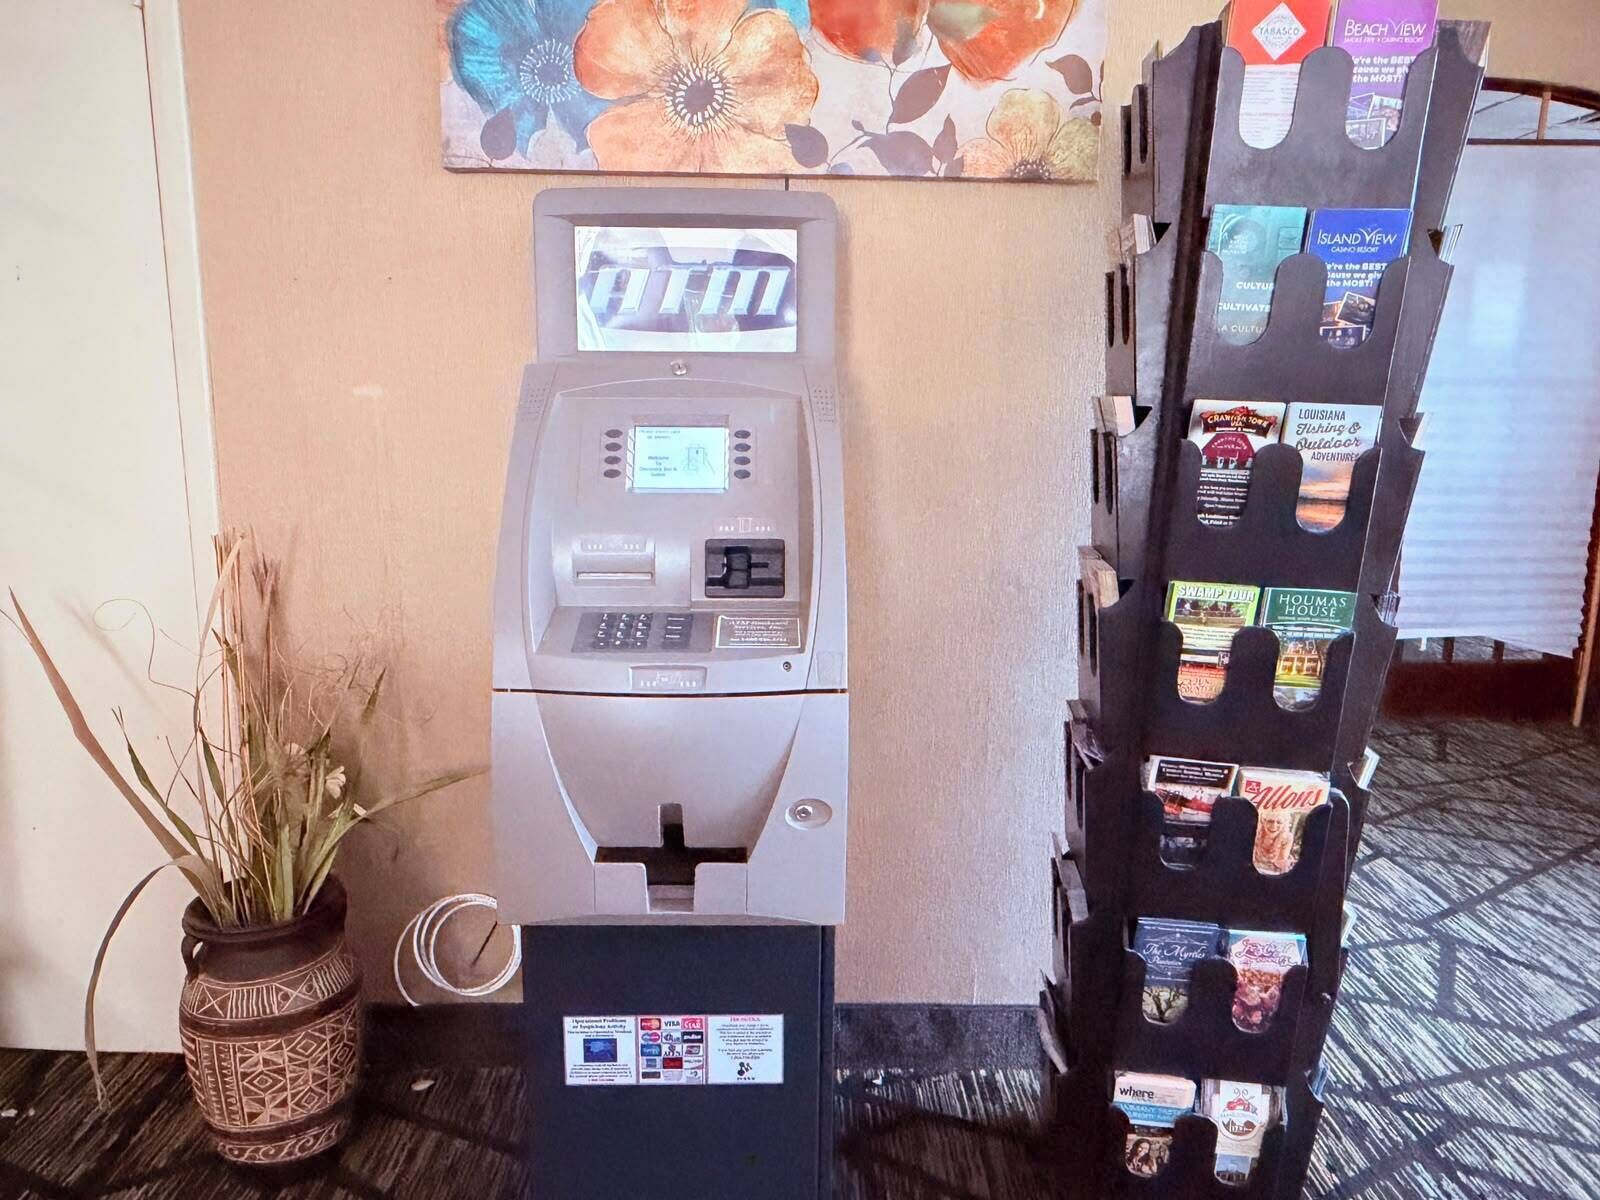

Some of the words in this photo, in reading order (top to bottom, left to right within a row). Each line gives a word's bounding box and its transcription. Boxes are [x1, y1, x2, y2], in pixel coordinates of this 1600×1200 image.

[1258, 24, 1300, 37] TABASCO
[1344, 19, 1388, 36] BEACH
[1389, 18, 1427, 36] VIEW
[1373, 56, 1389, 65] the
[1381, 66, 1394, 74] we
[1352, 74, 1368, 83] the
[1370, 75, 1402, 84] MOST!
[1317, 228, 1361, 245] ISLAND
[1360, 226, 1397, 245] VIEW
[1345, 262, 1360, 270] the
[1362, 263, 1387, 271] BEST
[1343, 280, 1373, 288] MOST!
[1298, 408, 1346, 421] LOUISIANA
[1296, 422, 1345, 437] Fishing
[1348, 421, 1361, 435] &
[1296, 437, 1361, 451] Outdoor
[1177, 585, 1224, 601] SWAMP
[1225, 589, 1255, 603] TOUR
[1279, 593, 1347, 607] HOUMAS
[1284, 605, 1337, 618] HOUSE
[1251, 784, 1324, 810] Allons
[1143, 942, 1164, 956] The
[1119, 1085, 1155, 1099] where
